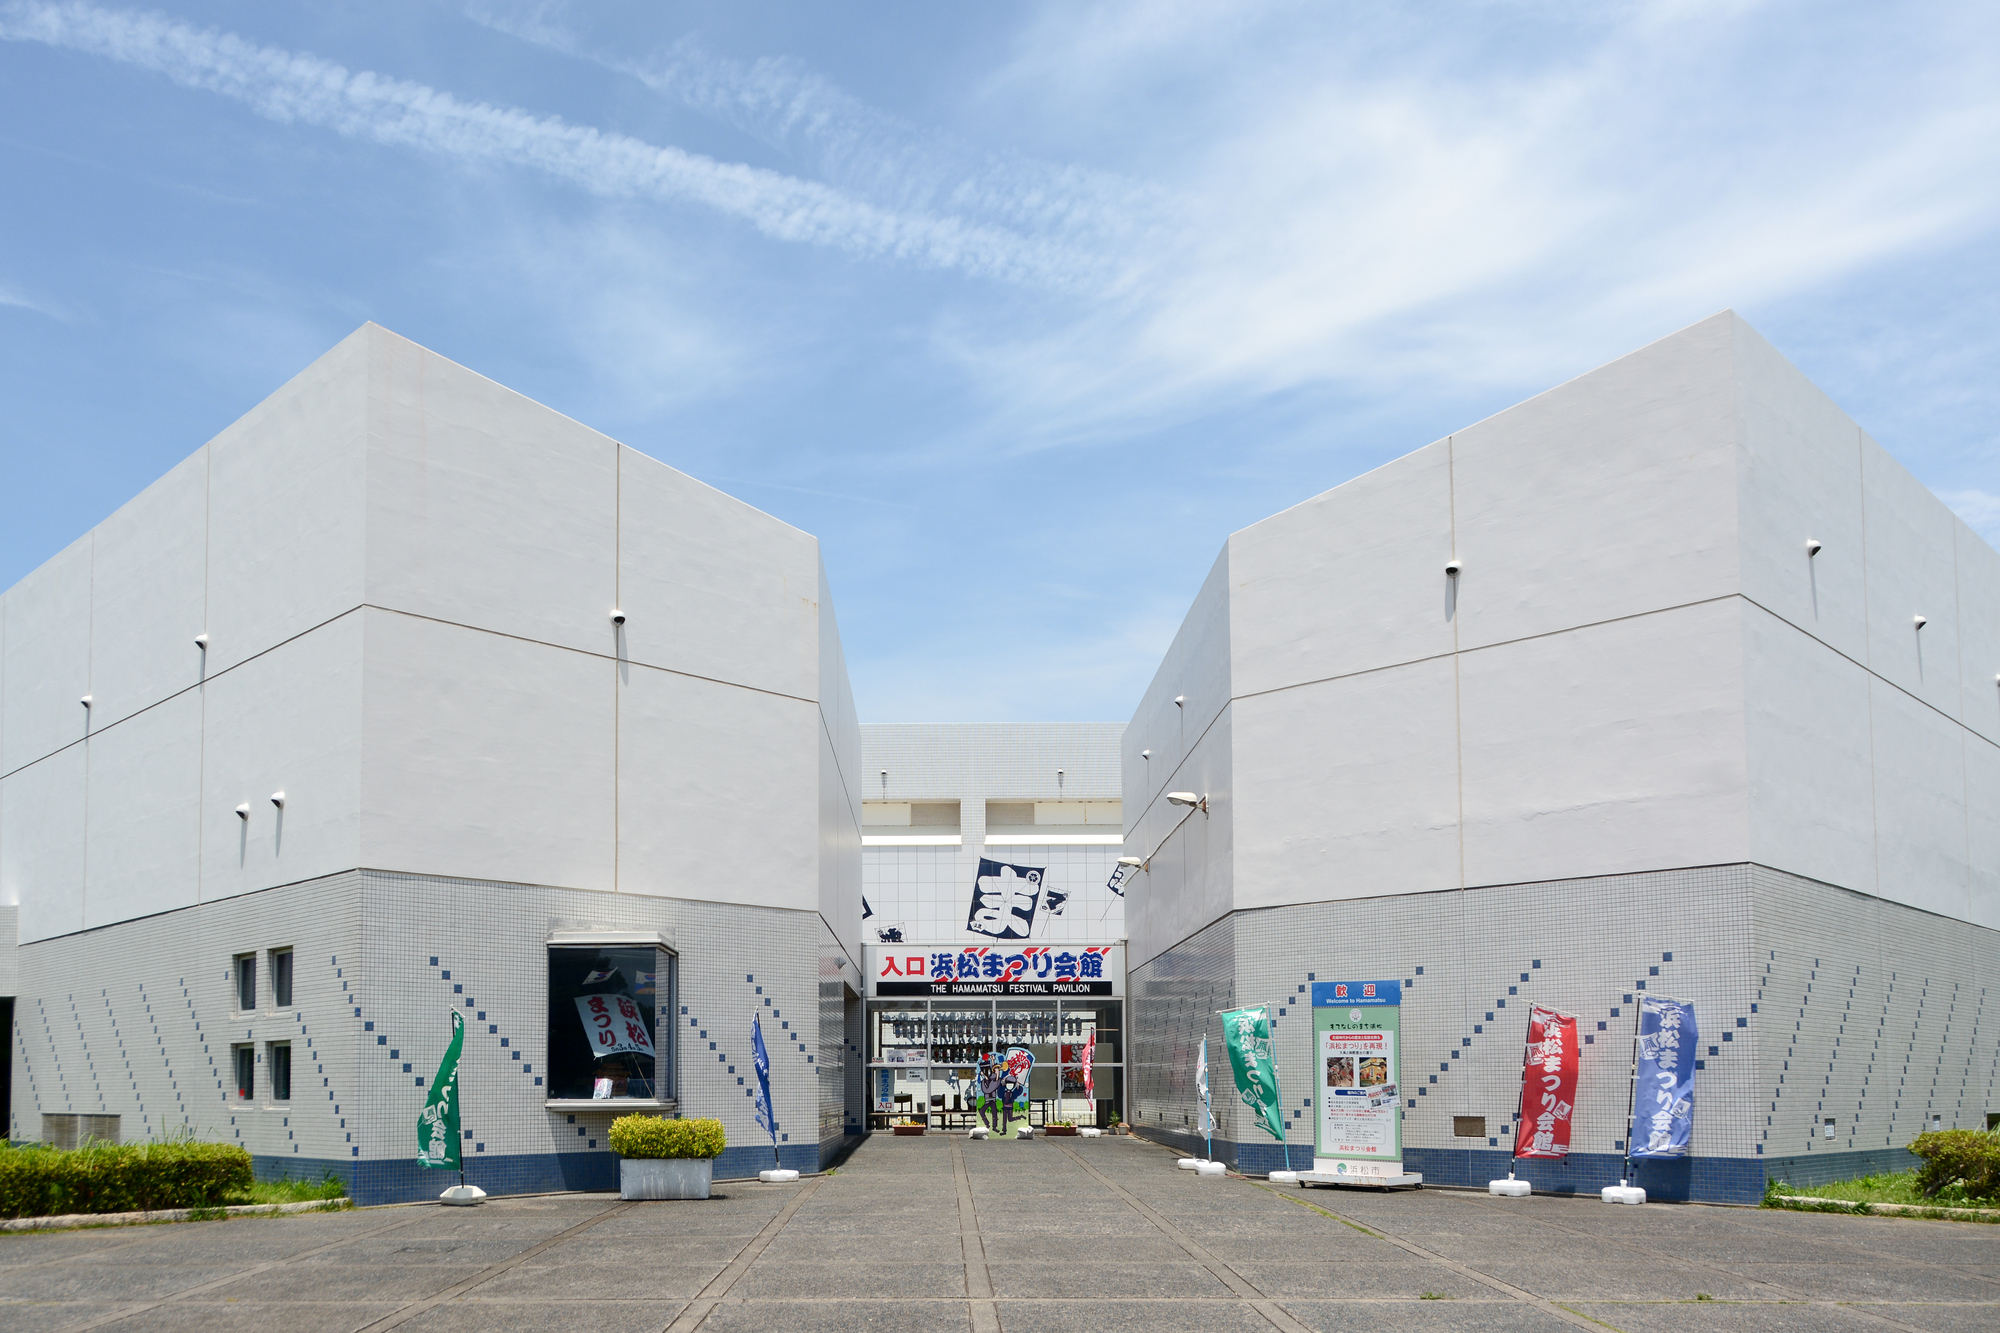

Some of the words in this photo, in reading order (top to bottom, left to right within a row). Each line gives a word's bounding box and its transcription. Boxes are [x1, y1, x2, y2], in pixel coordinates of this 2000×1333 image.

[974, 865, 1040, 937] ま
[880, 956, 925, 977] 入口
[930, 951, 1103, 978] 浜松まつり会館
[931, 984, 947, 993] THE
[952, 984, 1004, 993] HAMAMATSU
[1009, 984, 1049, 993] FESTIVAL
[1053, 984, 1090, 993] PAVILION
[587, 995, 617, 1048] まつり
[616, 997, 650, 1048] 浜松
[1533, 1020, 1564, 1151] 浜松まつり会館
[1648, 1008, 1681, 1151] 浜松まつり会館
[1339, 1144, 1377, 1153] 浜松まつり会館
[1349, 1164, 1380, 1176] 浜松市
